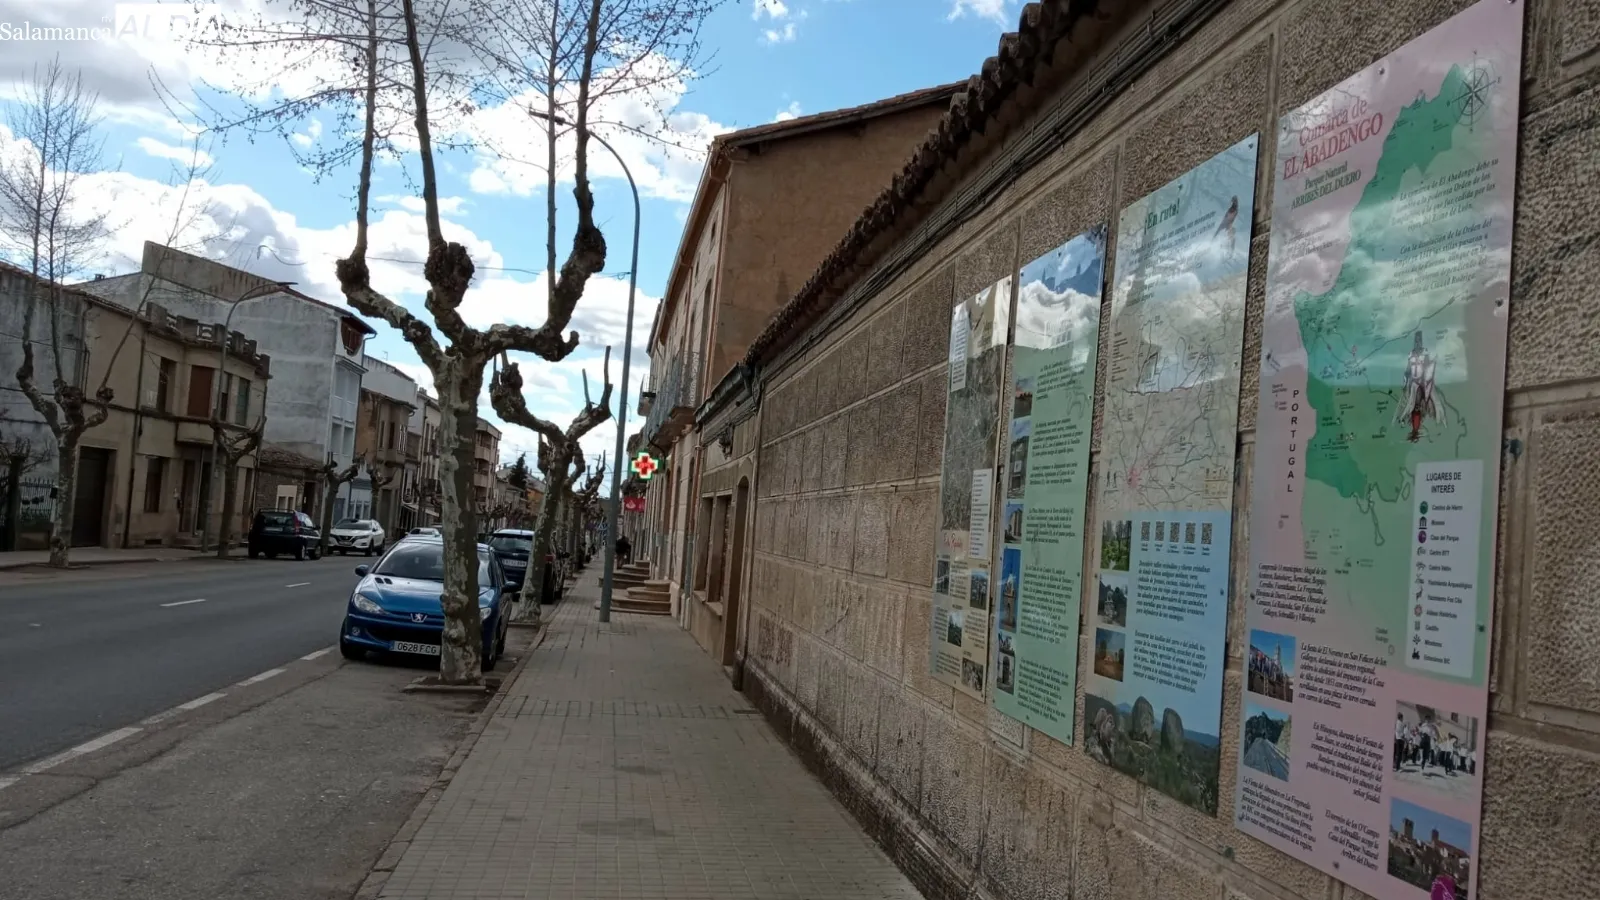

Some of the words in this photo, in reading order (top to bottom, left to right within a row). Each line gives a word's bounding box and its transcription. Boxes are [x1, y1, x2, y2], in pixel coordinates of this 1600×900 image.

[1299, 108, 1348, 146] Comarca
[1352, 97, 1367, 119] de
[1283, 156, 1299, 180] EL
[1301, 112, 1383, 172] ABADENGO
[1325, 161, 1347, 180] Natural
[1320, 180, 1334, 197] DEL
[1335, 170, 1361, 191] DUERO
[1287, 389, 1299, 493] PORTUGAL
[1426, 472, 1452, 481] LUGARES
[1454, 472, 1461, 480] DE
[1431, 484, 1455, 493] INTERÉS
[398, 643, 418, 652] 0628
[420, 645, 436, 653] FCG
